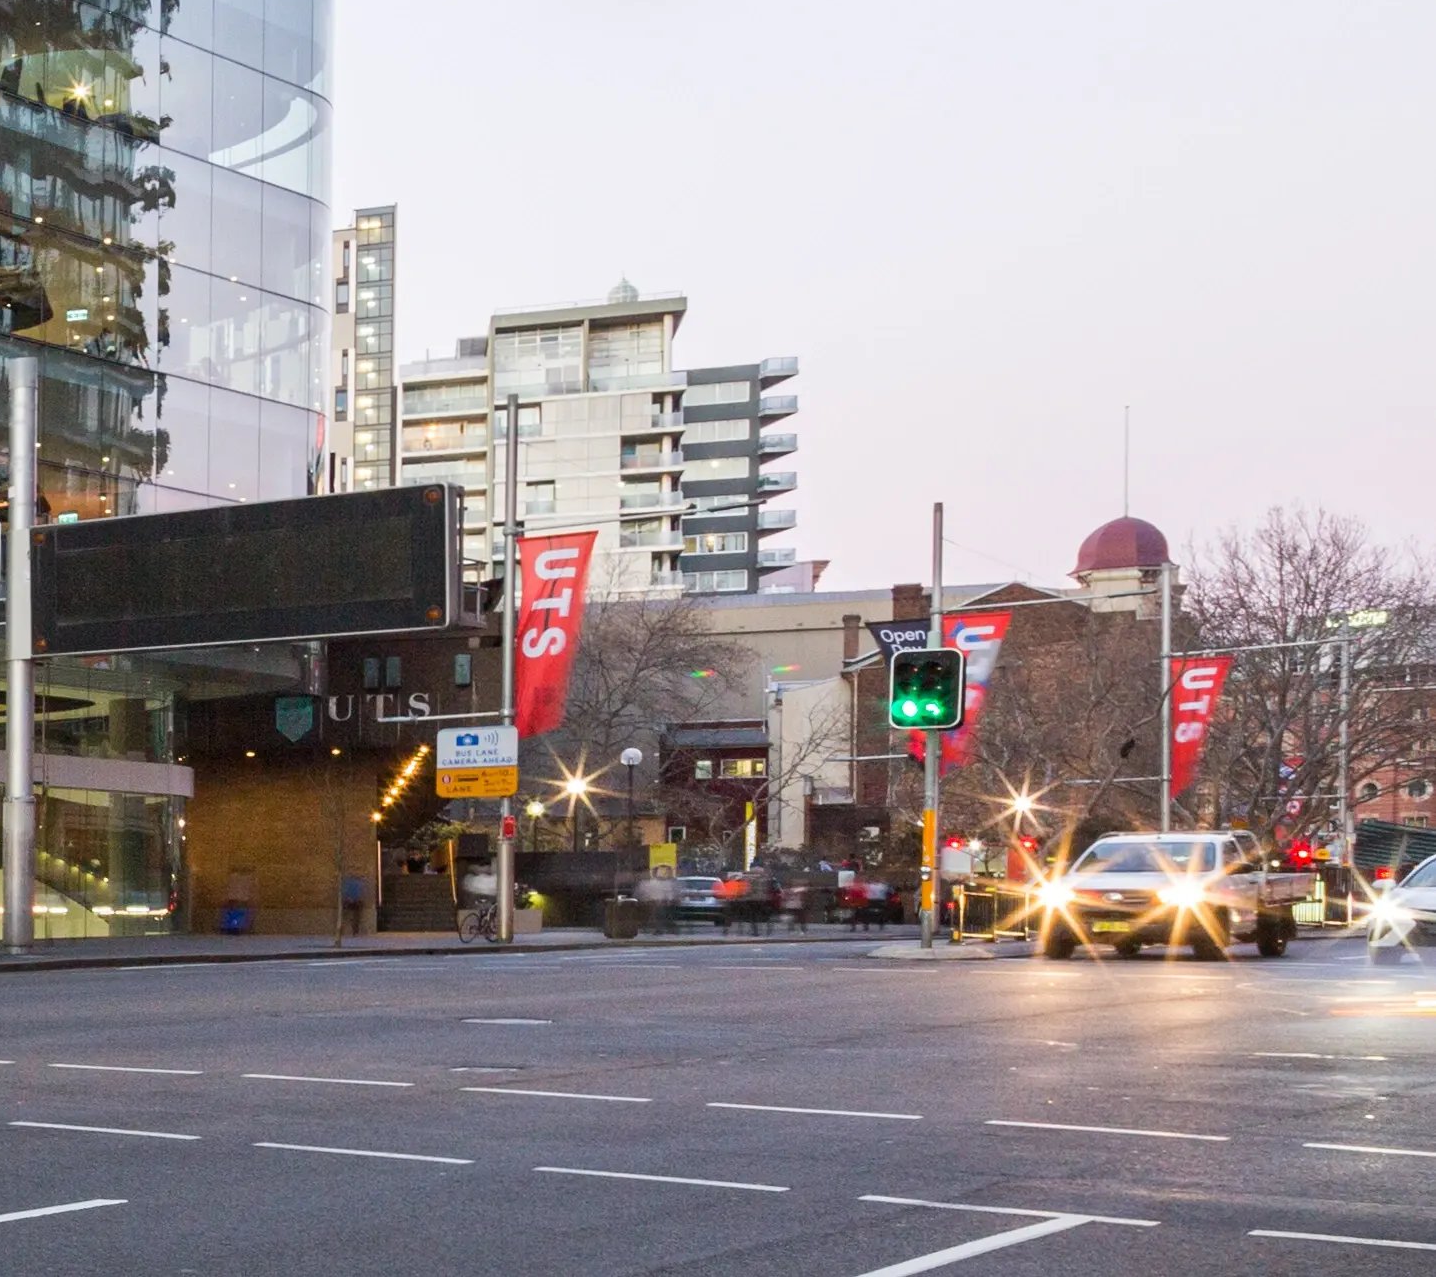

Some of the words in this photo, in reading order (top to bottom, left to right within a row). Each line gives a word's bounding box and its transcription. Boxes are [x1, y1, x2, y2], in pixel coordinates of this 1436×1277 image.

[522, 548, 579, 659] UTS
[880, 629, 926, 644] Open
[328, 693, 431, 723] UTS
[1175, 667, 1218, 743] UTS
[442, 757, 478, 766] CAMERA
[483, 756, 513, 764] AHEAD
[476, 748, 499, 756] LANE
